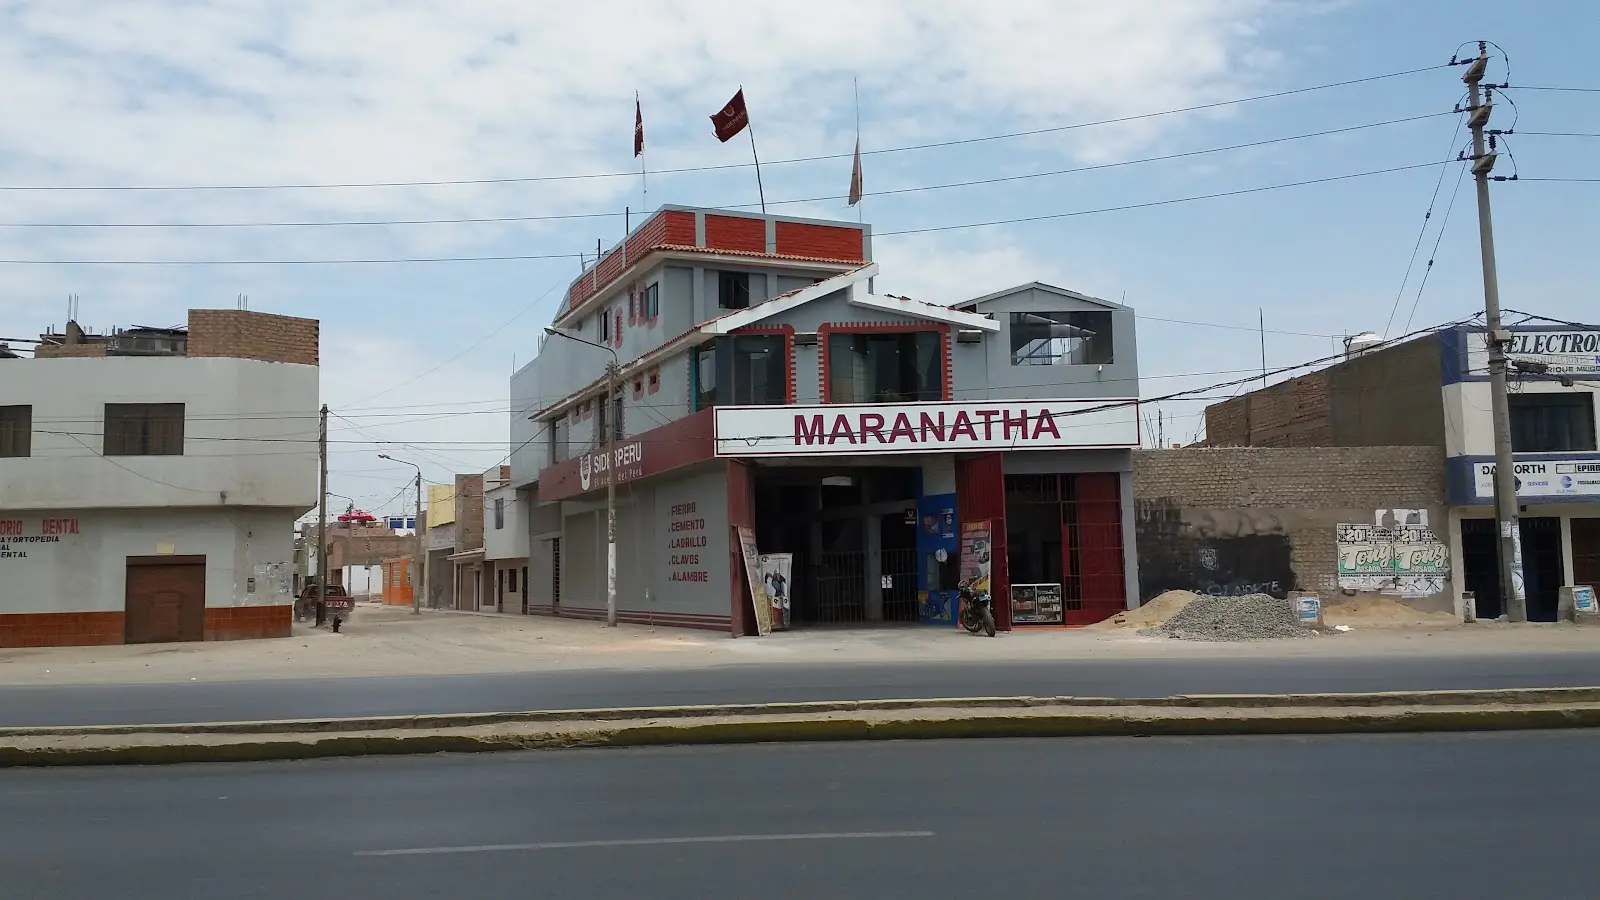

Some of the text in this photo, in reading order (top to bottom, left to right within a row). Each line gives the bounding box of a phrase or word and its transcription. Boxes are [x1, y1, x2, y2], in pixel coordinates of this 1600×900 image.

[794, 408, 1061, 446] MARANATHA
[1482, 464, 1546, 475] DAORTH
[671, 502, 696, 516] FIERRO
[42, 519, 79, 535] DENTAL
[671, 518, 705, 532] CEMENTO
[671, 536, 707, 549] LADRILLO
[671, 554, 699, 565] CLAVOS
[1341, 545, 1392, 569] Tony
[672, 571, 708, 582] ALAMBRE
